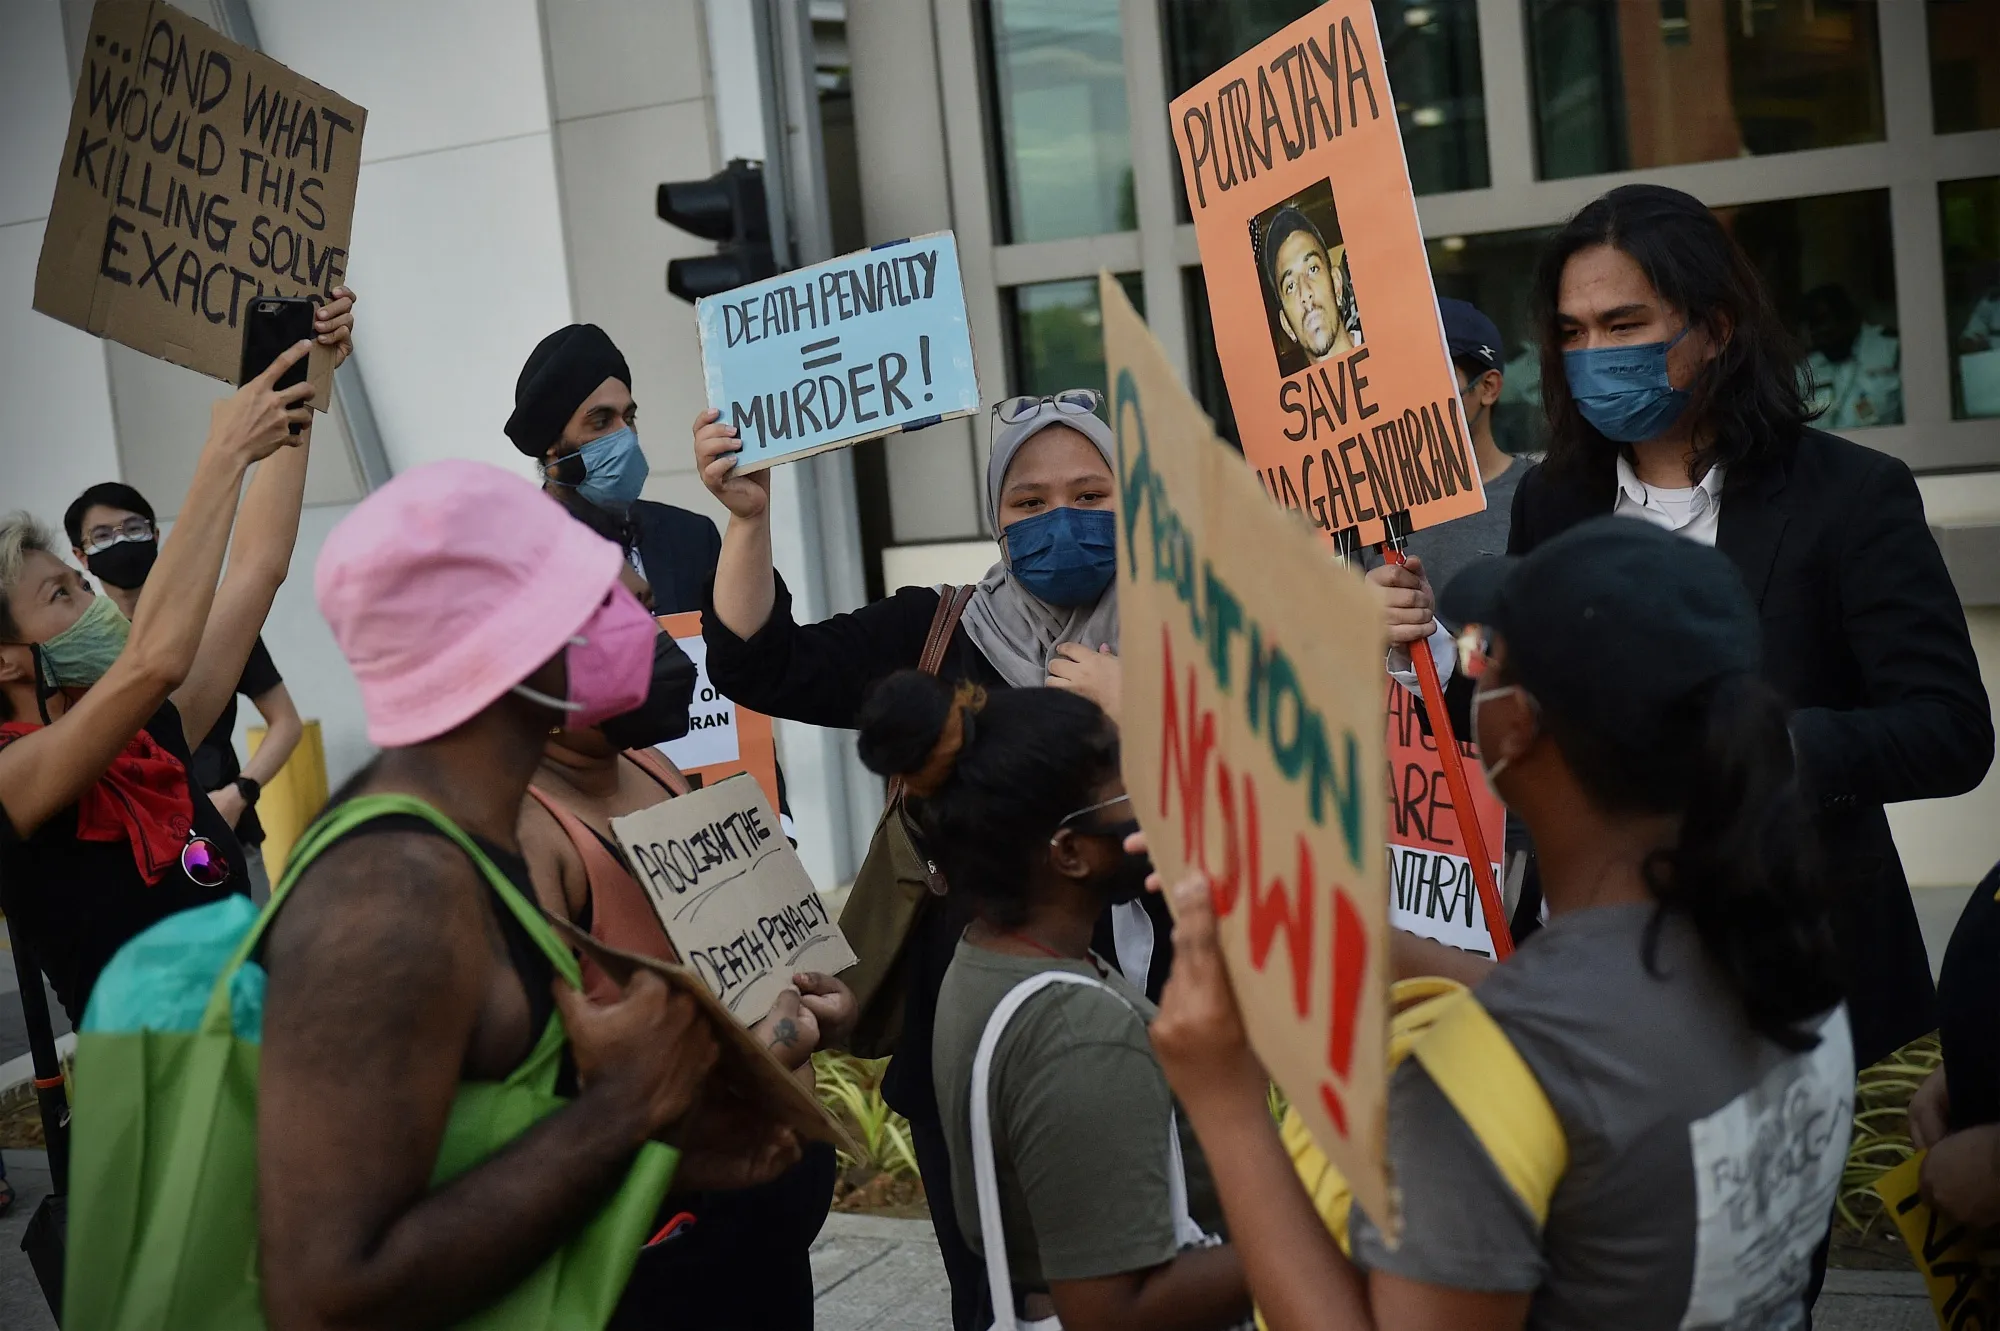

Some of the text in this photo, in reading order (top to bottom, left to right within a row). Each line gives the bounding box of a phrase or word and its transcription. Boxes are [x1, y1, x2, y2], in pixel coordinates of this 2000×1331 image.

[88, 60, 326, 232] WOULD THIS
[242, 71, 355, 174] WHAT
[1182, 16, 1378, 208] PUTRAJAYA
[72, 127, 346, 298] KILLING SOLVE
[100, 214, 326, 332] EXACT
[722, 249, 937, 348] DEATH PENALTY
[1280, 348, 1379, 441] SAVE
[632, 806, 770, 900] ABOLISH THE
[1388, 846, 1498, 932] NTHRA
[689, 928, 773, 1001] DEATH
